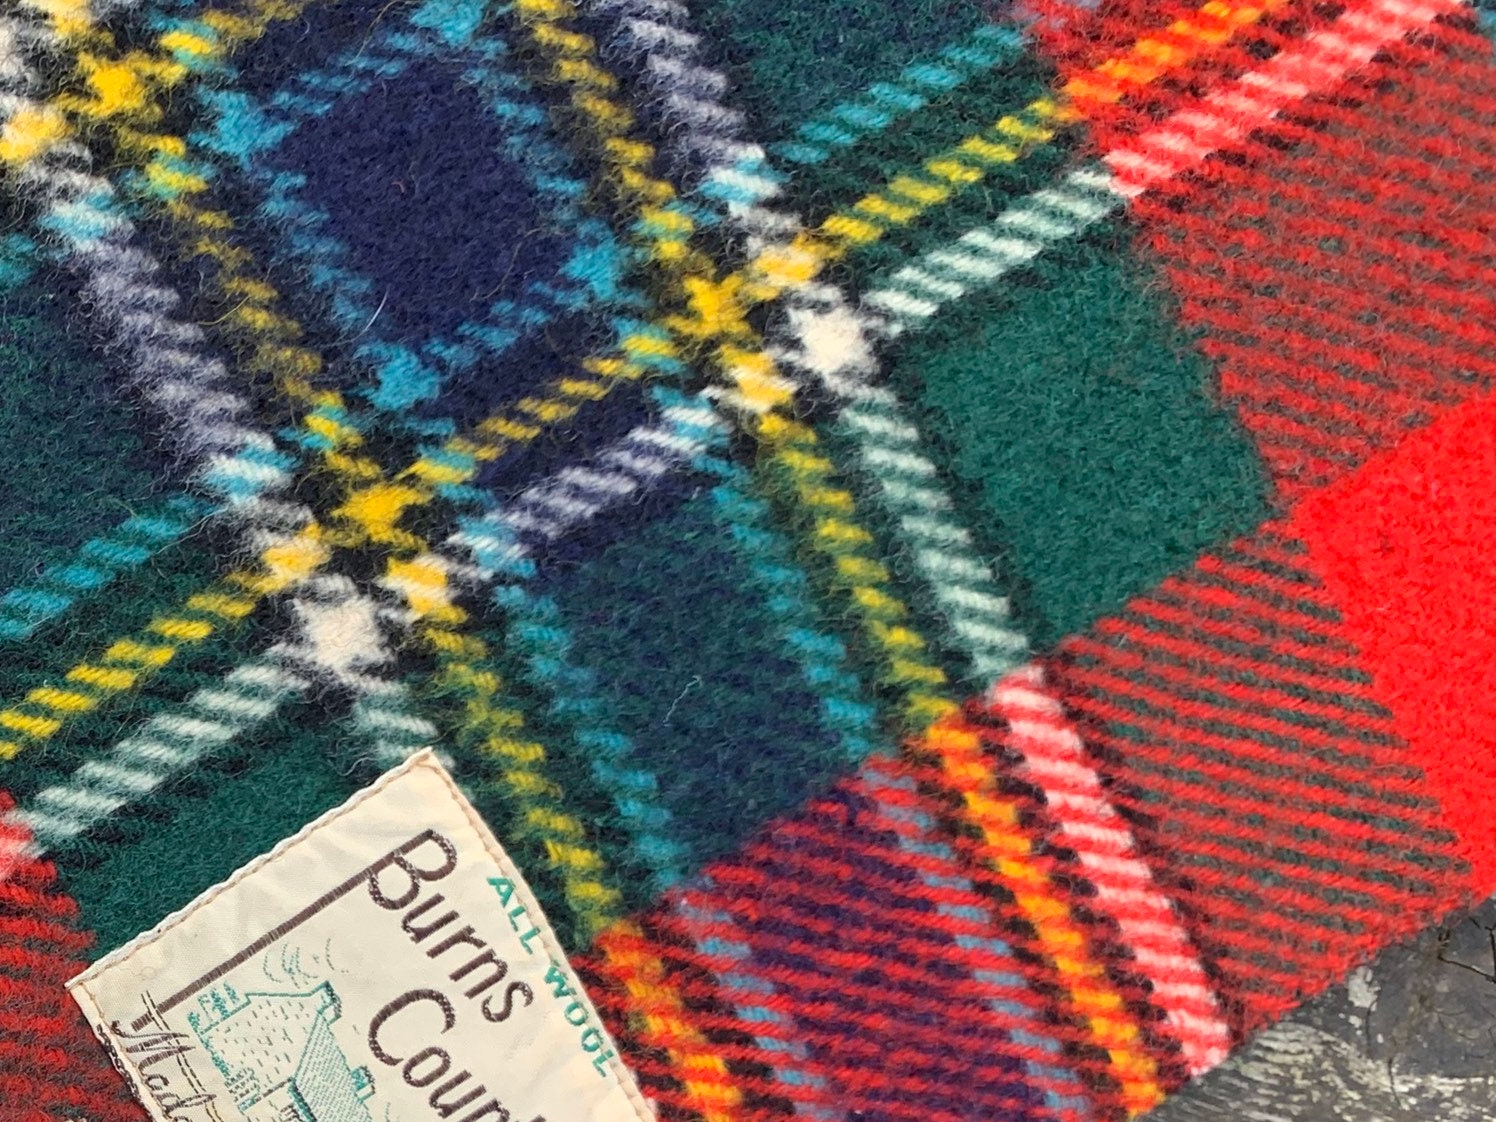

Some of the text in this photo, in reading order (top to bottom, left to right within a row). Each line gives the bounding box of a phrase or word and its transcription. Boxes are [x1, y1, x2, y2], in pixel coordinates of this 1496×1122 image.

[366, 829, 533, 1023] Burns
[487, 875, 616, 1078] ALL WOOL
